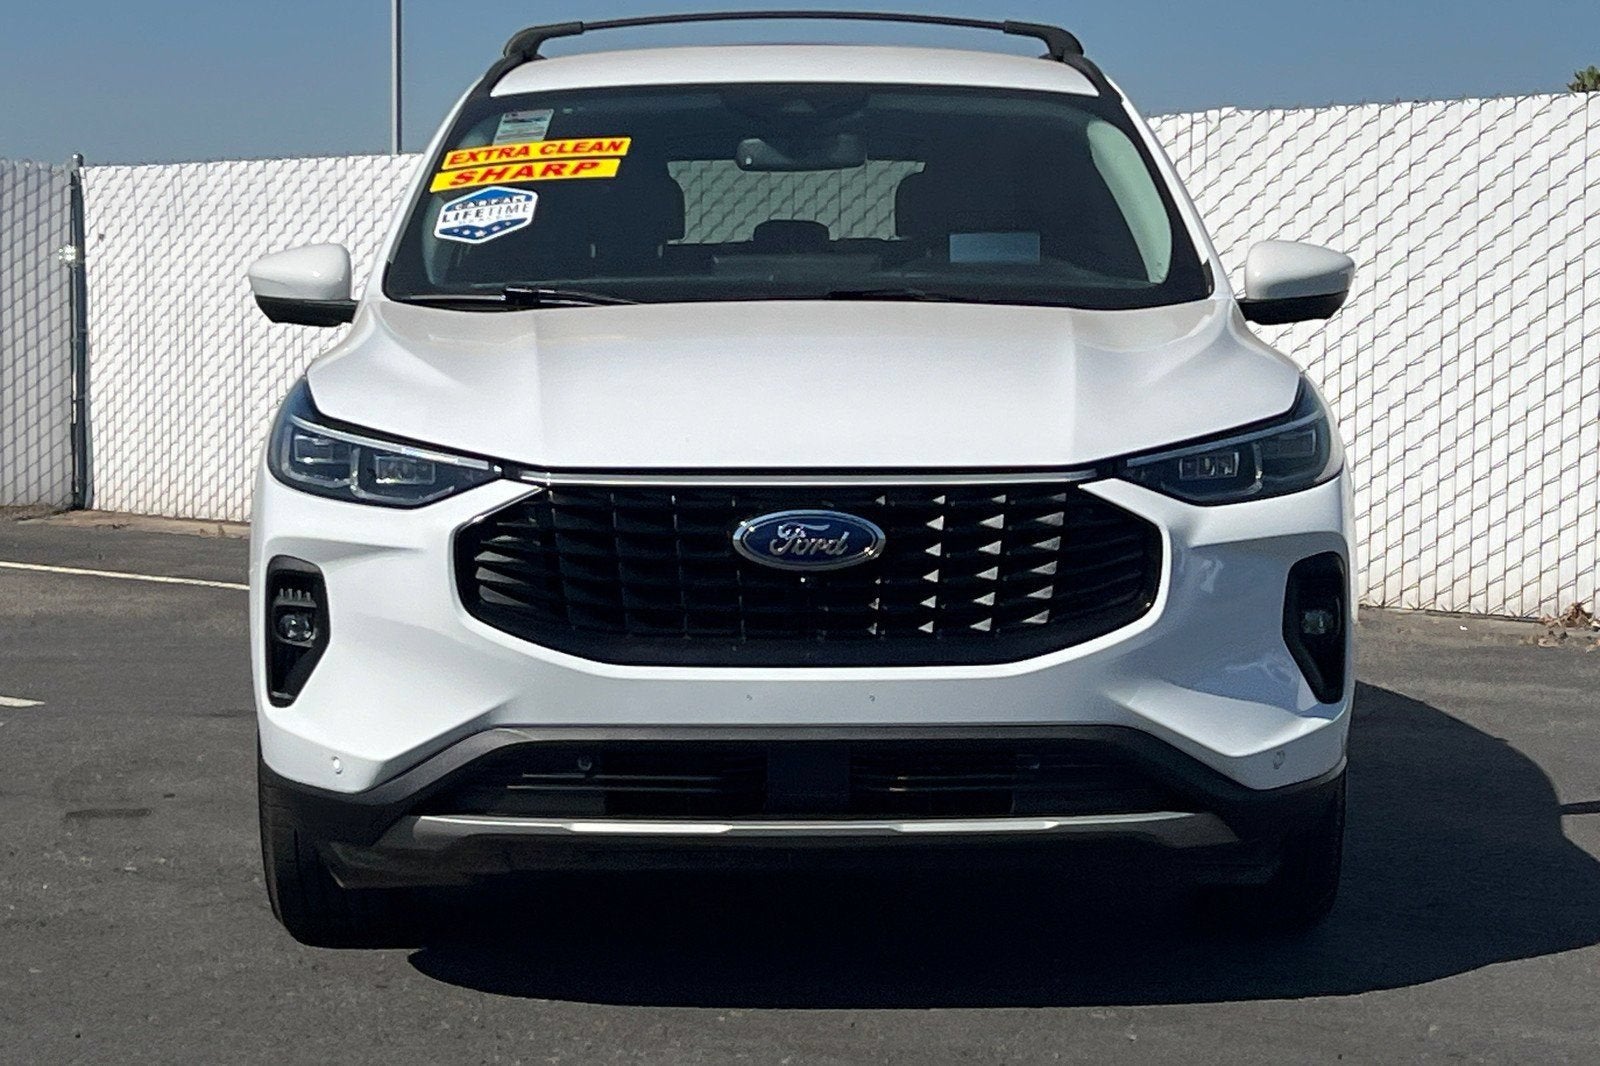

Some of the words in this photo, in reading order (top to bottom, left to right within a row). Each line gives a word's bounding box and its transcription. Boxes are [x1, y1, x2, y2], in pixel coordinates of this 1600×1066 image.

[449, 145, 530, 165] EXTRA
[540, 141, 624, 156] CLEAN
[449, 161, 600, 186] SHARP
[441, 203, 530, 223] LIFETIME
[769, 521, 850, 556] Ford
